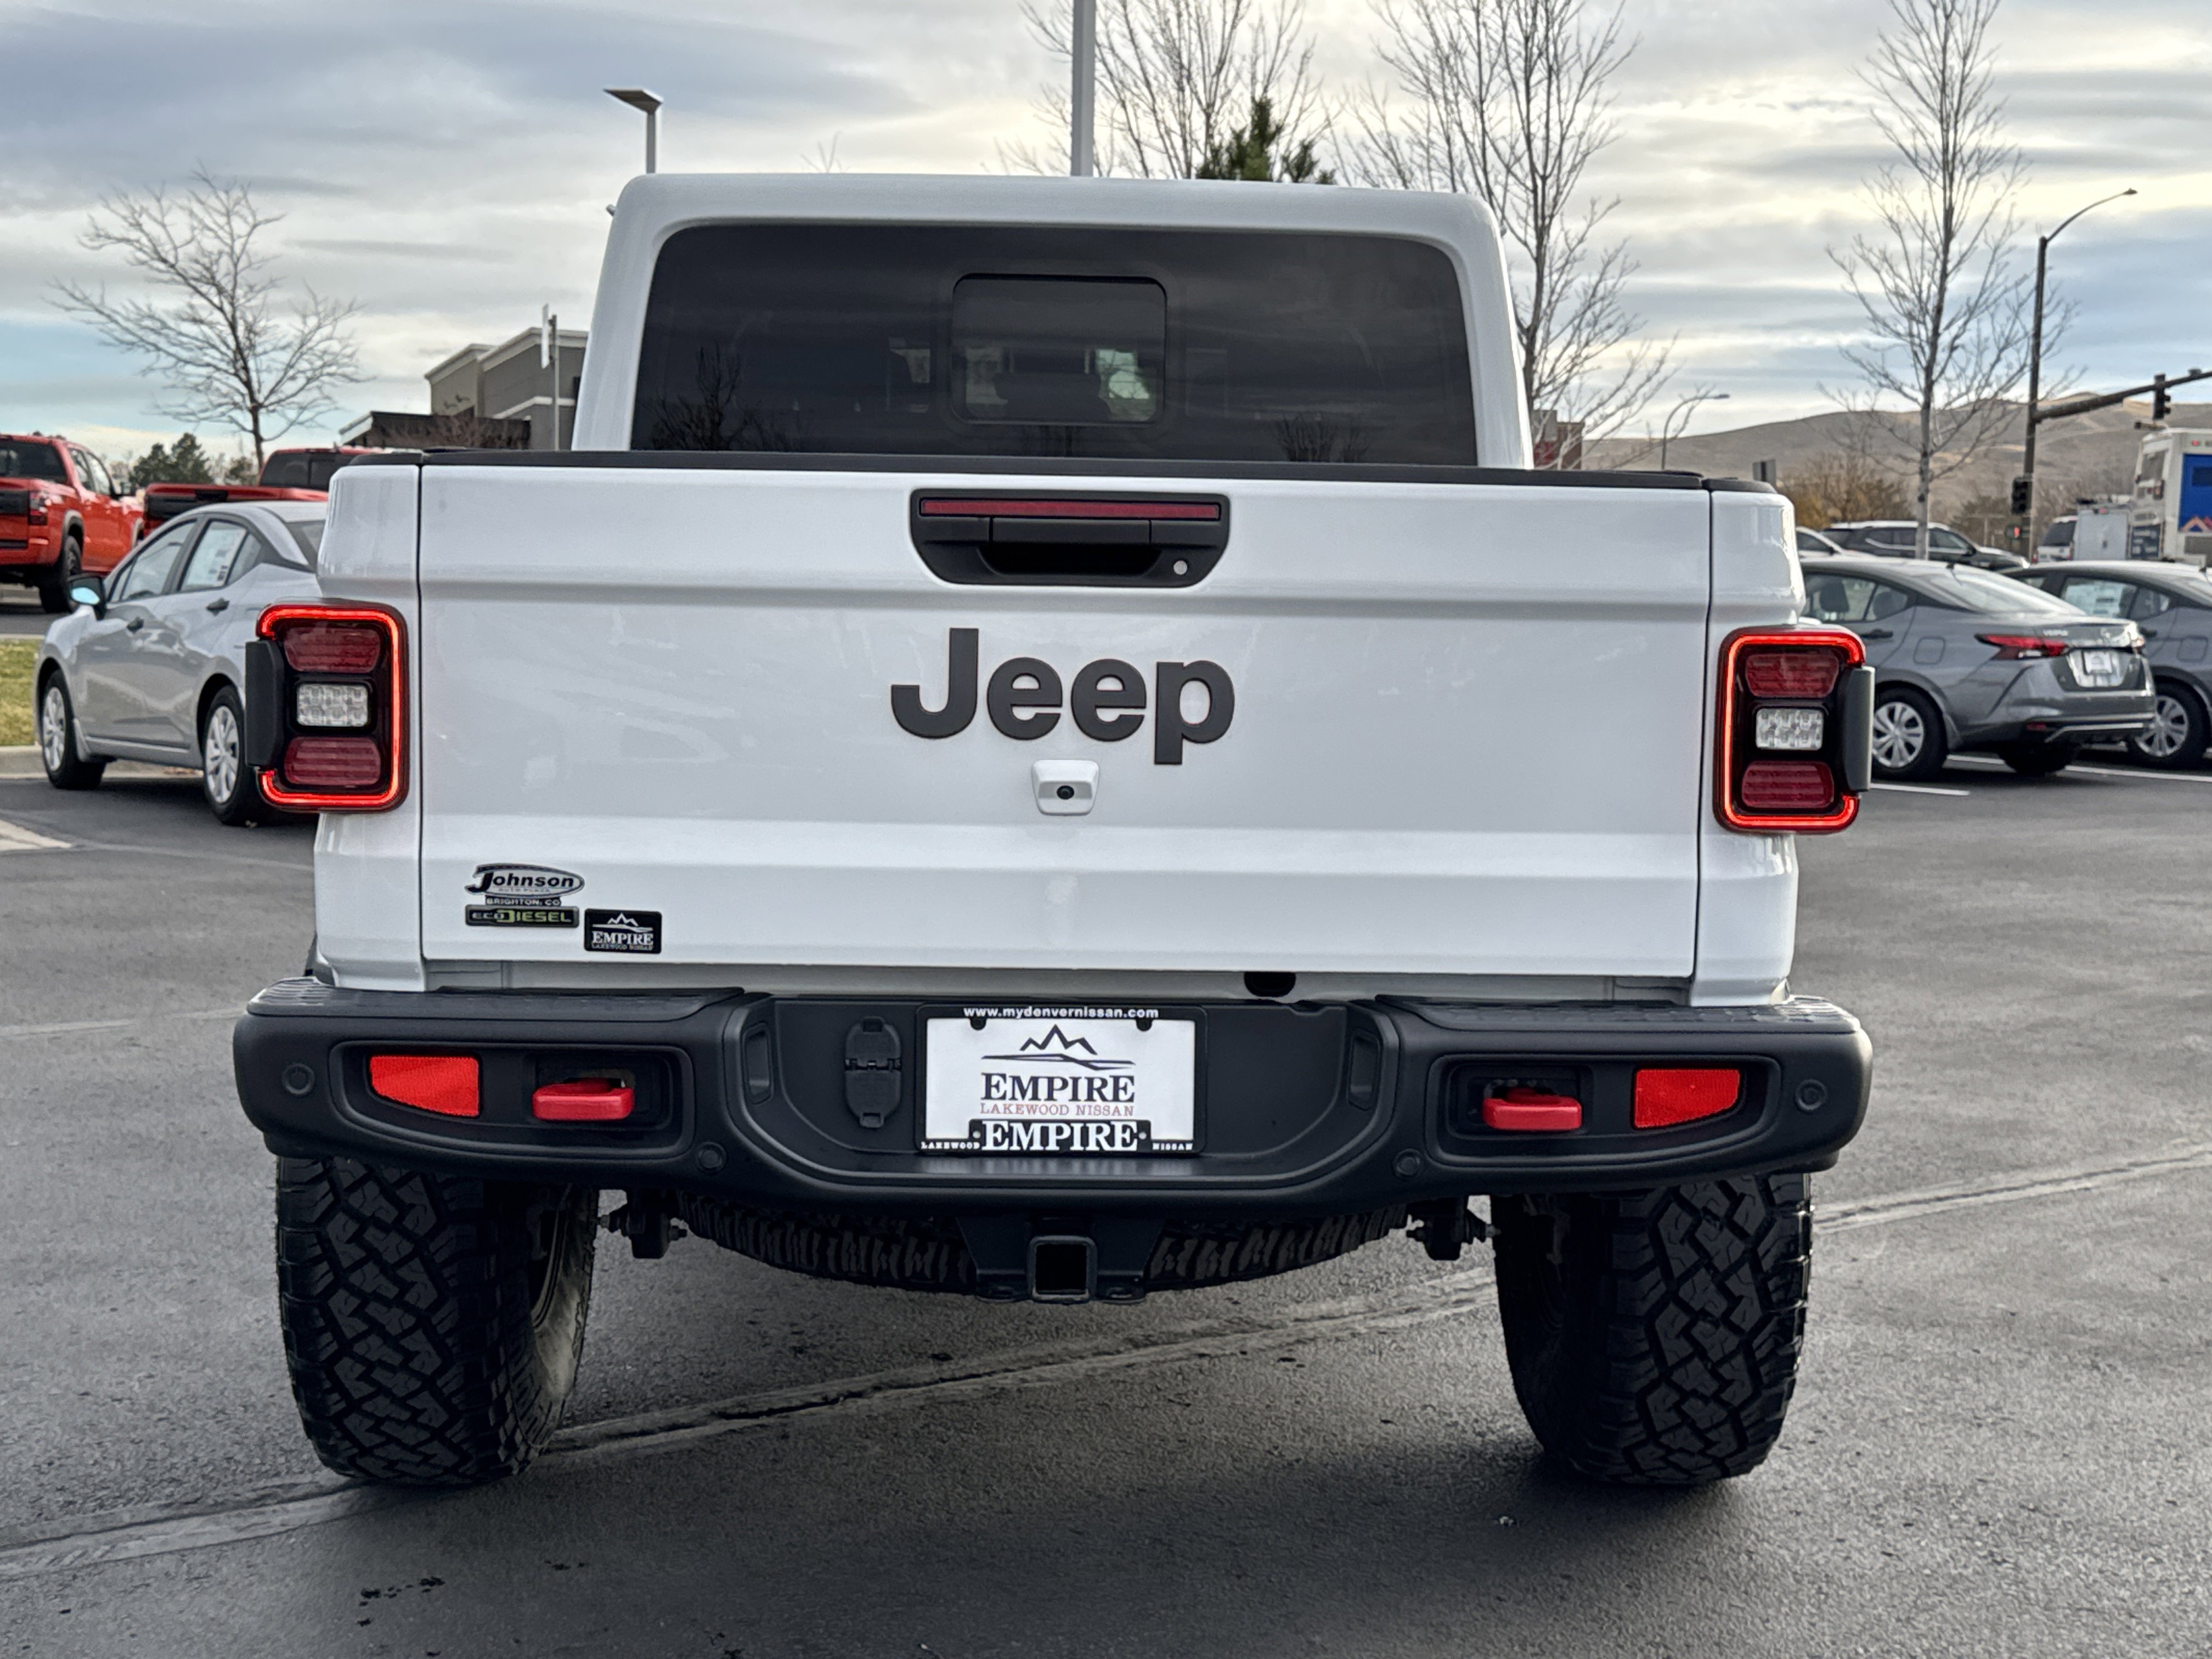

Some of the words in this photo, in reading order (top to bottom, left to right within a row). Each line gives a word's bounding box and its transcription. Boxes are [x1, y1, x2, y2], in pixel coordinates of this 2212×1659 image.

[891, 628, 1235, 765] Jeep
[465, 871, 574, 892] Johnson
[591, 931, 653, 945] EMPIRE
[963, 1006, 1159, 1019] www.mydenvernissan.com
[980, 1072, 1135, 1103] EMPIRE
[980, 1103, 1069, 1116] LAKEWOOD
[1075, 1104, 1134, 1117] NISSAN
[981, 1120, 1138, 1152] EMPIRE
[921, 1141, 980, 1150] LAKEWOOD
[1152, 1142, 1193, 1151] NISSAN
